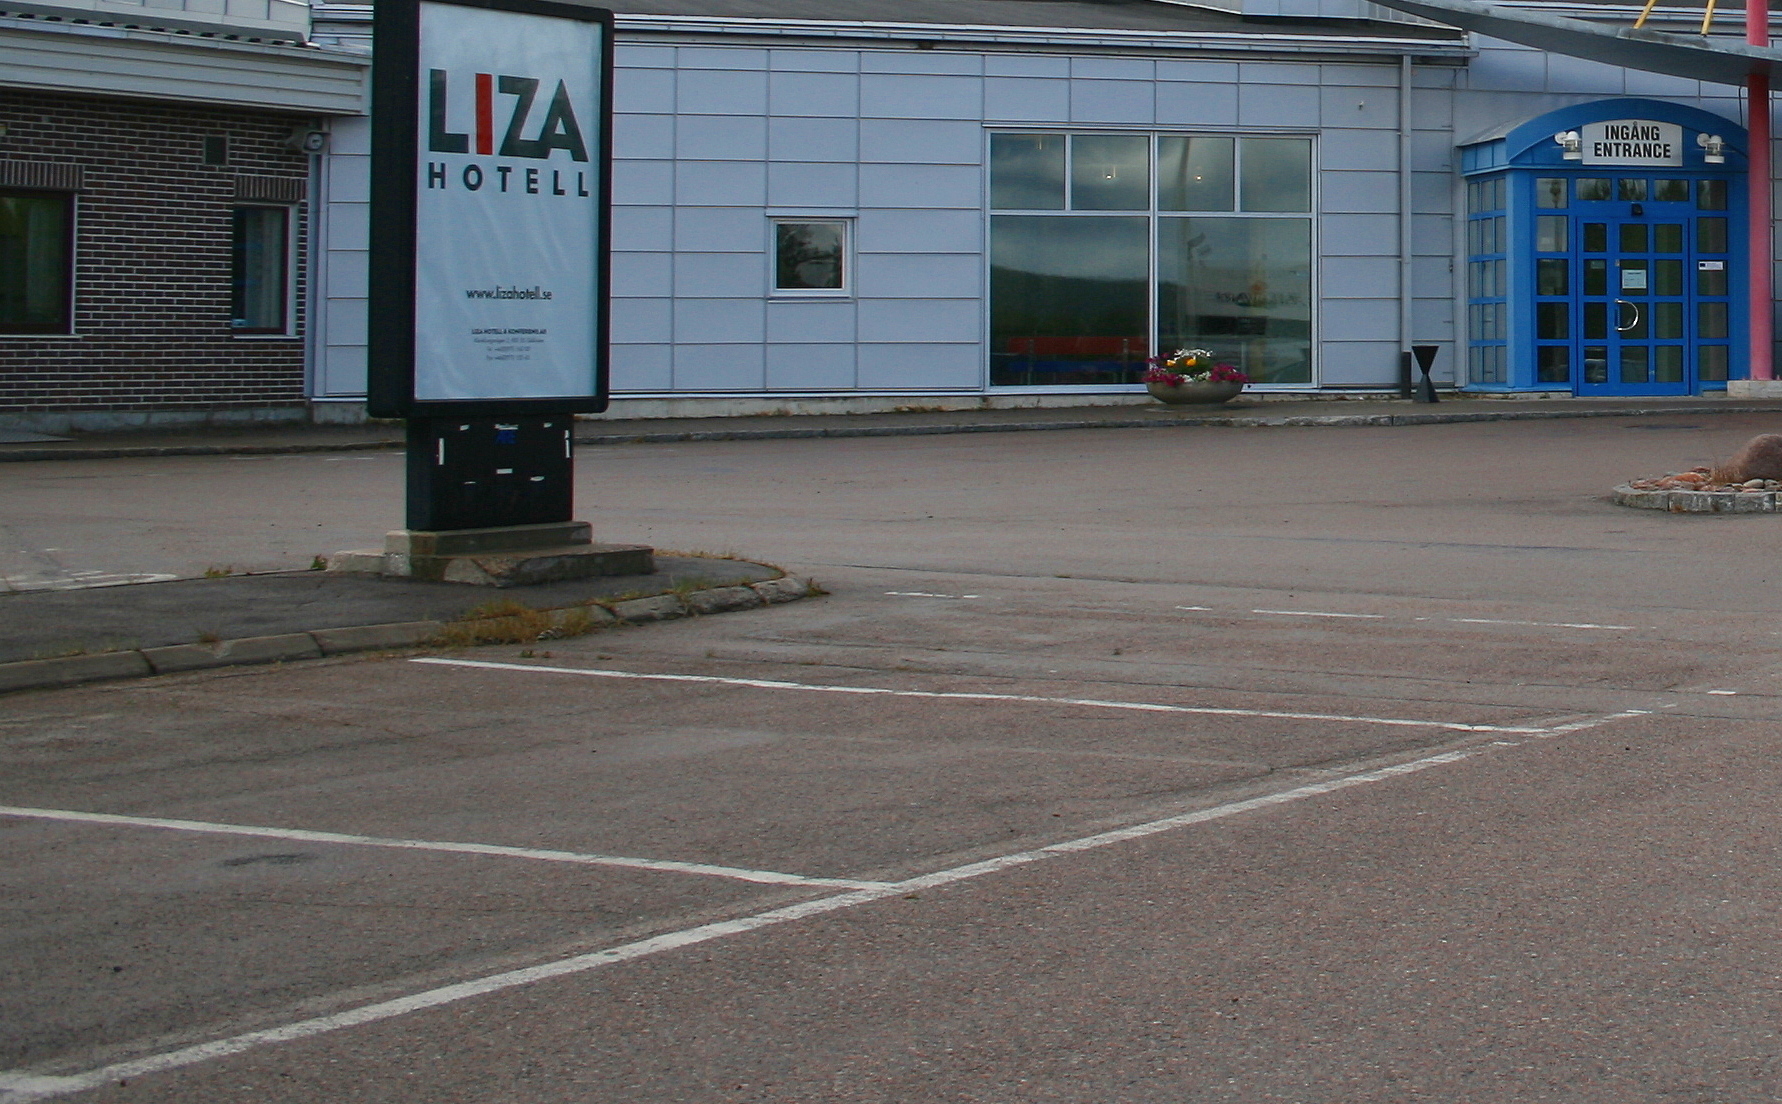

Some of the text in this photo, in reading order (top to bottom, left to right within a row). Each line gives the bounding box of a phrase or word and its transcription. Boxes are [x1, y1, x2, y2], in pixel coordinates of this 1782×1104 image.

[429, 68, 589, 162] LIZA
[1605, 121, 1660, 140] INGÅNG
[1594, 142, 1671, 158] ENTRANCE
[428, 162, 589, 197] HOTELL
[465, 284, 553, 300] www.lizahotell.se
